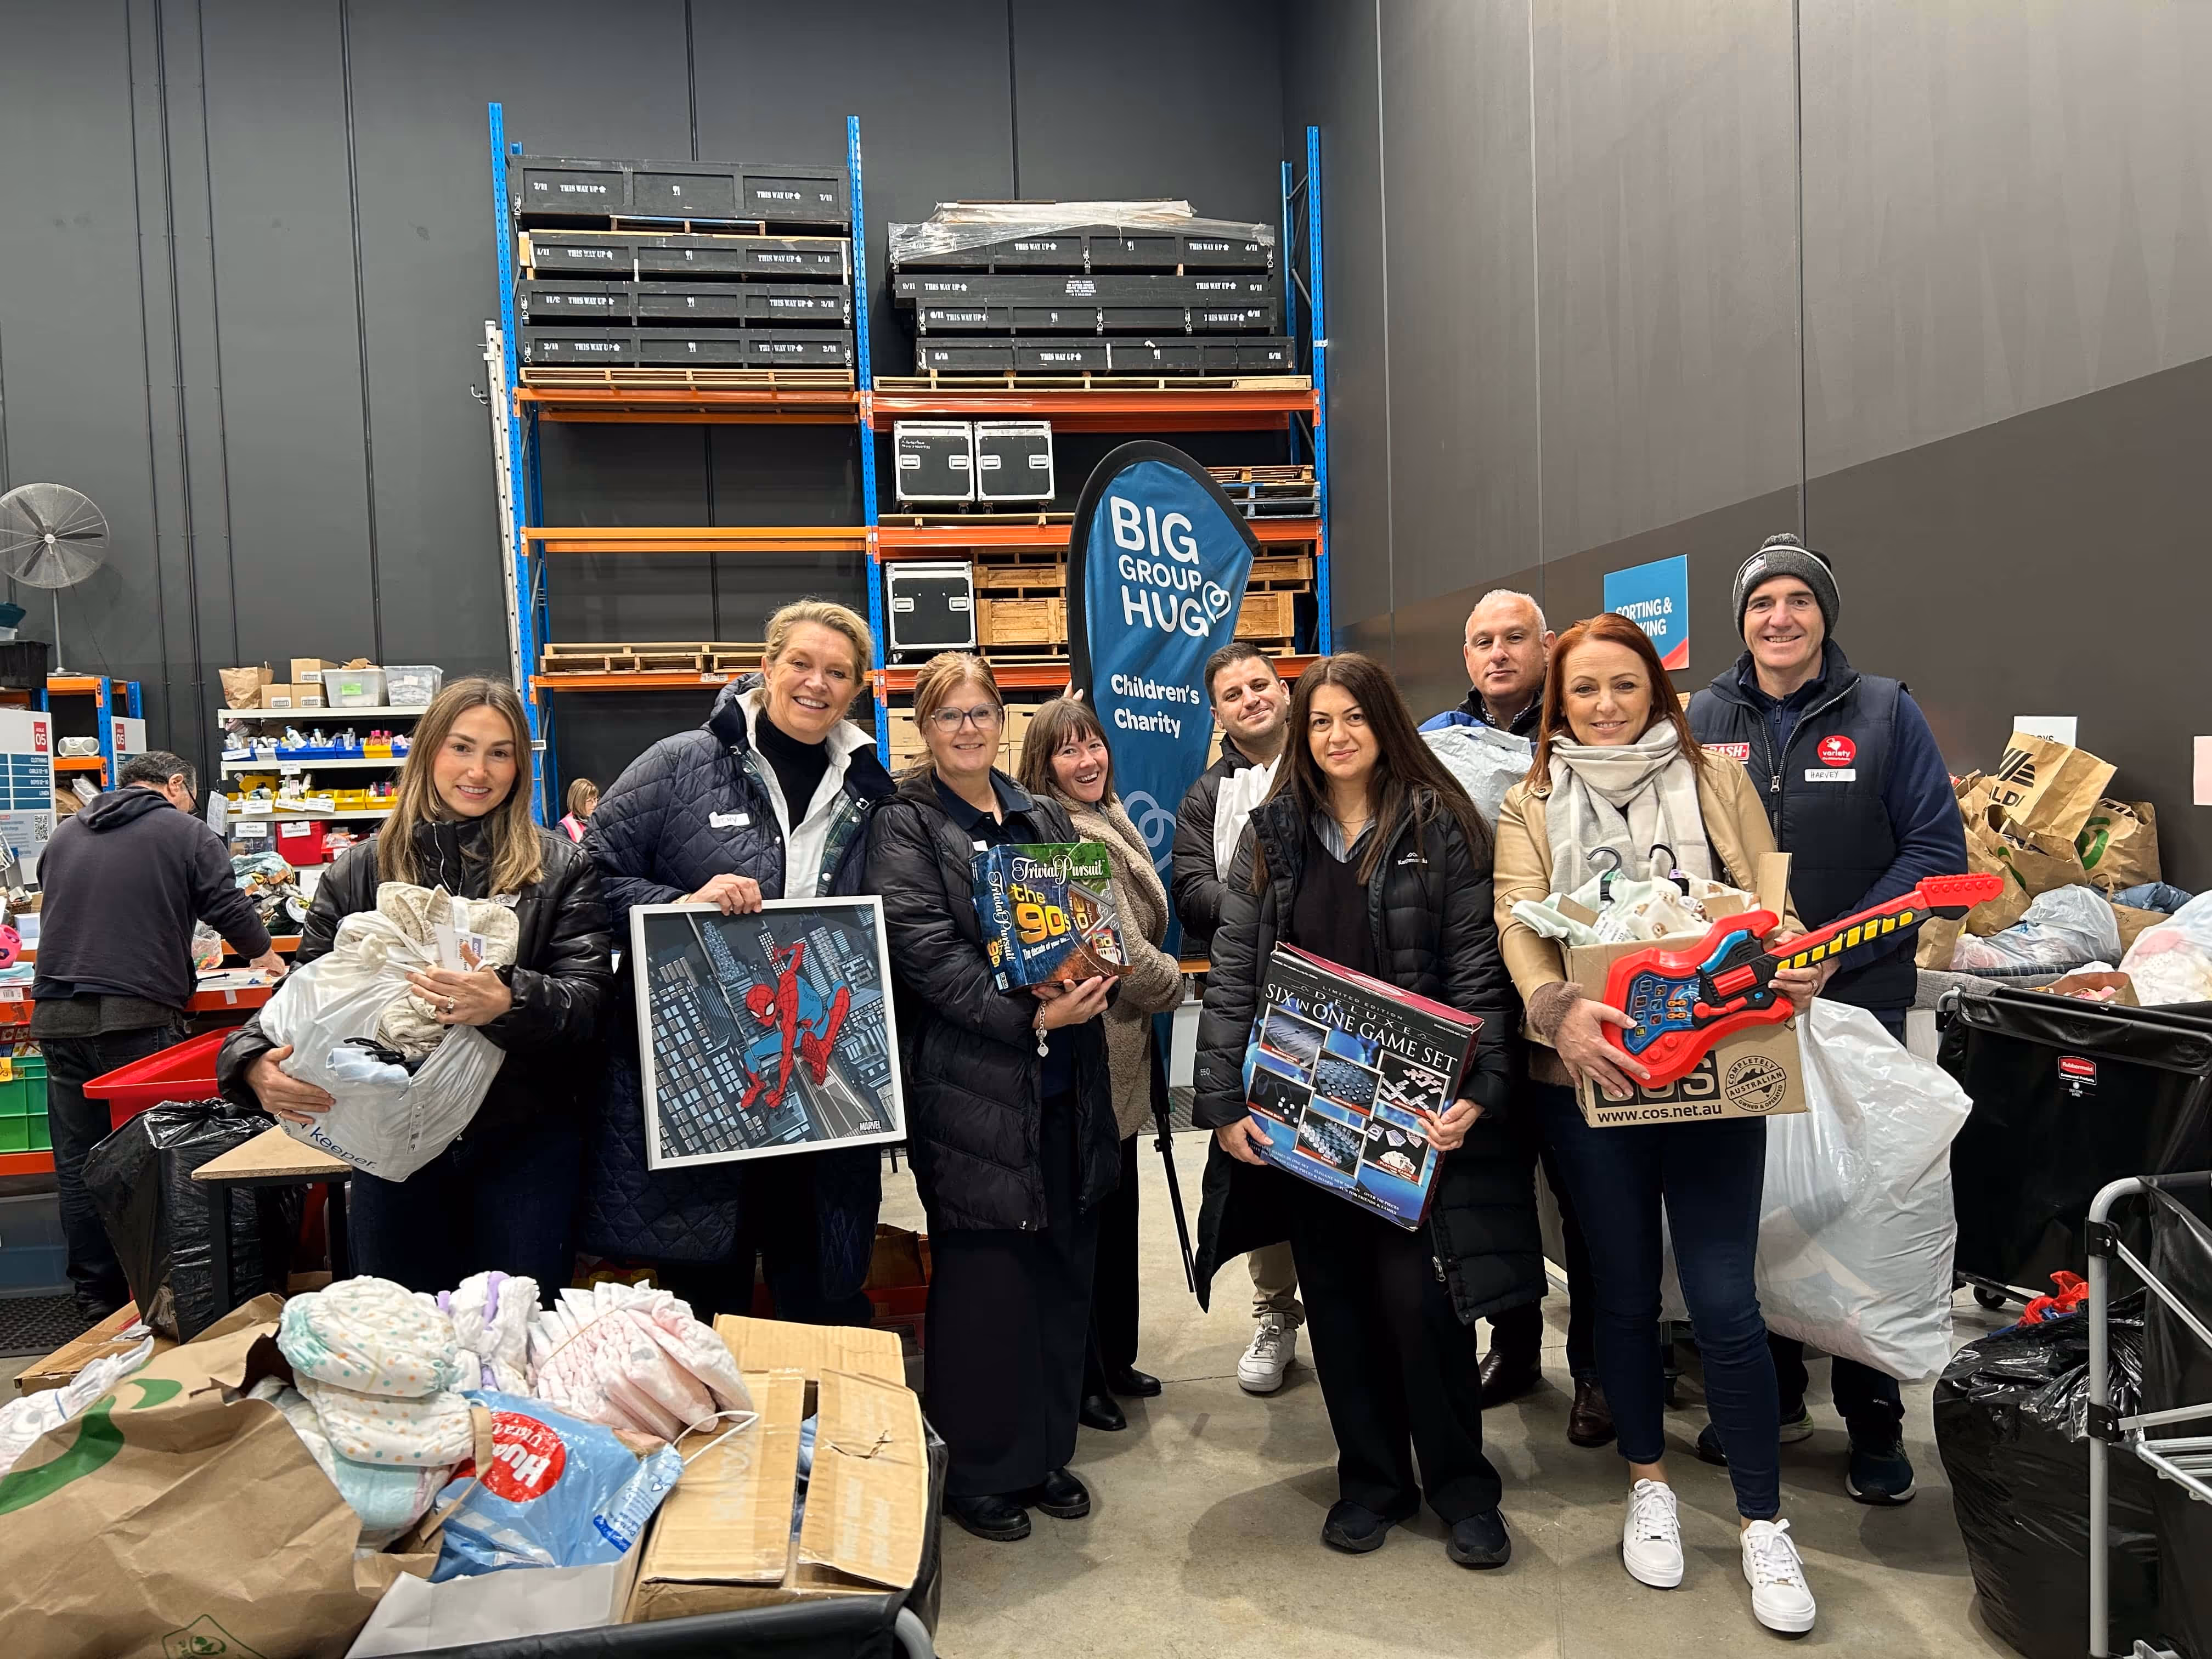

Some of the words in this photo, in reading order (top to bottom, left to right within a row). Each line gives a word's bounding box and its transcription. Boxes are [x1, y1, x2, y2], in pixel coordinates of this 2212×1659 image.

[1110, 495, 1199, 565] BIG
[1118, 554, 1201, 592] GROUP
[1121, 585, 1209, 637] HUG
[1663, 596, 1672, 614] &
[1111, 673, 1200, 706] Children's
[1114, 708, 1182, 740] Charity
[36, 734, 46, 746] 05
[116, 736, 125, 745] 05
[1012, 857, 1059, 882] Trivial
[1053, 854, 1103, 885] Pursuit
[988, 871, 1005, 917] Trivial
[1011, 883, 1046, 904] the
[993, 910, 1016, 961] Pursuit
[1016, 903, 1071, 944] 90s
[988, 941, 1001, 968] 90s
[1023, 949, 1032, 961] The
[1031, 944, 1046, 957] decade
[1046, 942, 1051, 950] of
[1051, 939, 1060, 949] your
[1315, 991, 1411, 1035] DELUXE
[1323, 985, 1359, 1003] LIMITED
[1364, 1002, 1403, 1020] EDITION
[1266, 983, 1295, 1007] SIX
[1295, 998, 1310, 1012] IN
[1312, 1003, 1356, 1032] ONE
[1359, 1022, 1418, 1057] GAME
[1421, 1046, 1458, 1073] SET
[1728, 1058, 1775, 1085] COMPLETELY
[2062, 1062, 2093, 1072] Rubbermaid
[1730, 1071, 1783, 1097] AUSTRALIAN
[1739, 1099, 1758, 1109] OWNED
[1765, 1085, 1783, 1107] OPERATED
[859, 1120, 881, 1131] MARVEL
[1597, 1104, 1722, 1123] www.cos.net.au
[310, 1126, 377, 1169] keeper.
[1291, 1157, 1301, 1165] ONE
[1314, 1169, 1333, 1181] ELEGANT
[1344, 1183, 1360, 1193] DESIGN
[1364, 1192, 1376, 1200] OVER
[1384, 1201, 1400, 1210] PIECES
[1318, 1176, 1333, 1186] BOARD
[1358, 1194, 1376, 1205] FRIENDS
[1380, 1205, 1397, 1215] FAMILY
[503, 1425, 543, 1448] Ultra
